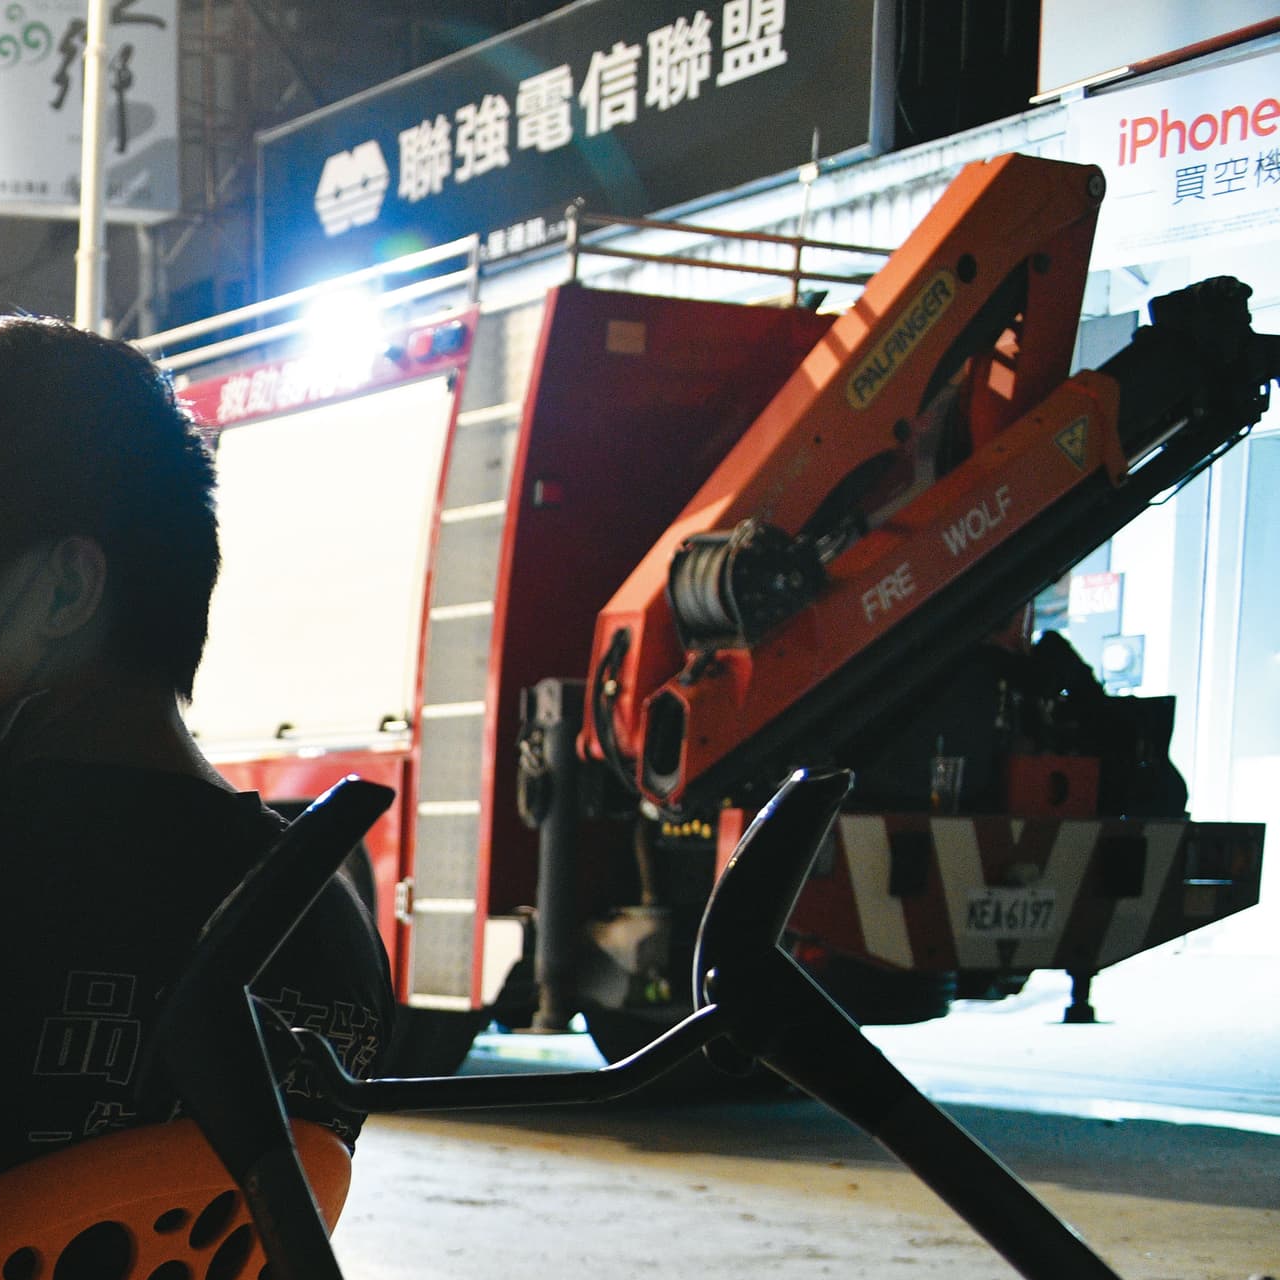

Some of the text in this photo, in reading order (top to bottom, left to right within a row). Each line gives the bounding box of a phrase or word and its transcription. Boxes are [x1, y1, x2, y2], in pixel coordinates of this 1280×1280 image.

[397, 0, 788, 203] 聯強電信聯盟
[1118, 98, 1280, 167] iPhone
[860, 485, 1015, 624] FIRE WOLF
